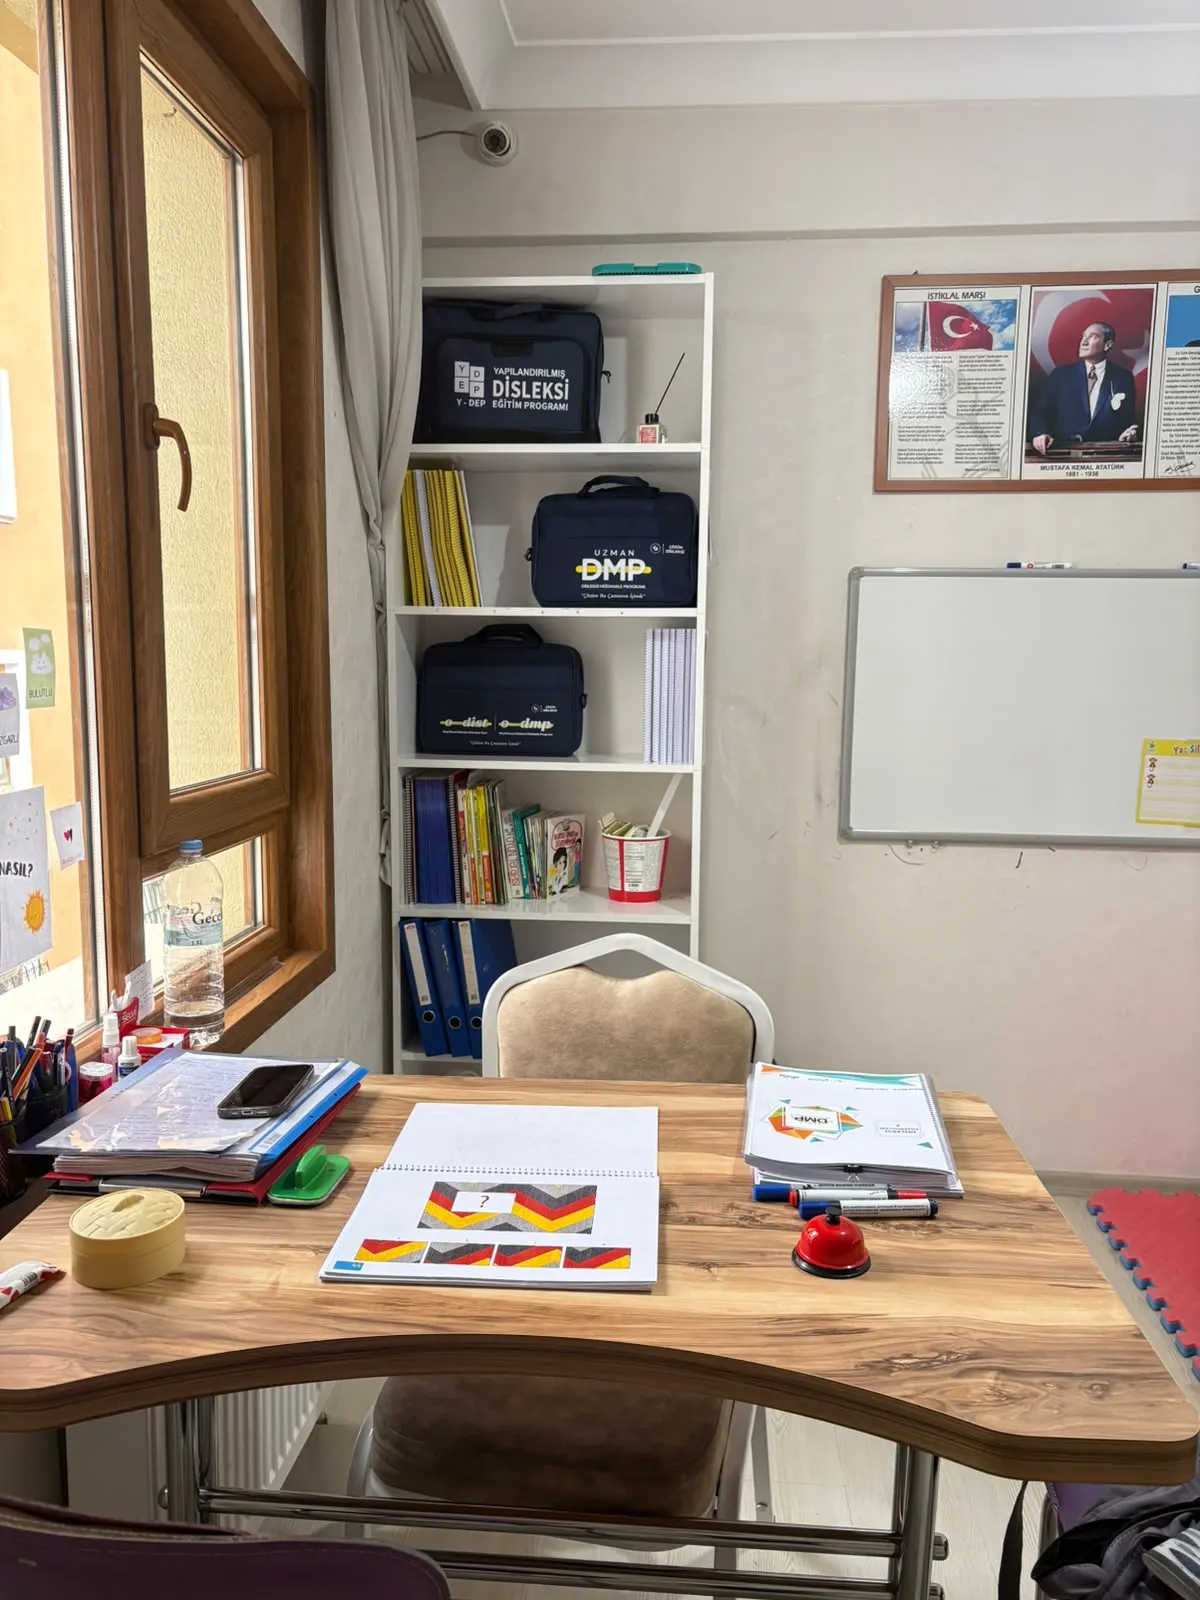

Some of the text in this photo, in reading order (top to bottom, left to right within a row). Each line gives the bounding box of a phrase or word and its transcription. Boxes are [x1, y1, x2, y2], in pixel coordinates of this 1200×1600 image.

[928, 291, 986, 301] İSTİKLAL MARŞI
[493, 367, 566, 379] YAPILANDIRILMIŞ
[492, 376, 569, 400] DİSLEKSİ
[492, 398, 569, 411] EĞİTİM PROGRAMI
[594, 549, 635, 557] UZMAN
[581, 558, 646, 582] DMP
[28, 687, 53, 699] BULUTLU
[0, 861, 33, 878] NASIL?
[794, 1116, 828, 1124] DMP
[480, 1195, 490, 1208] ?
